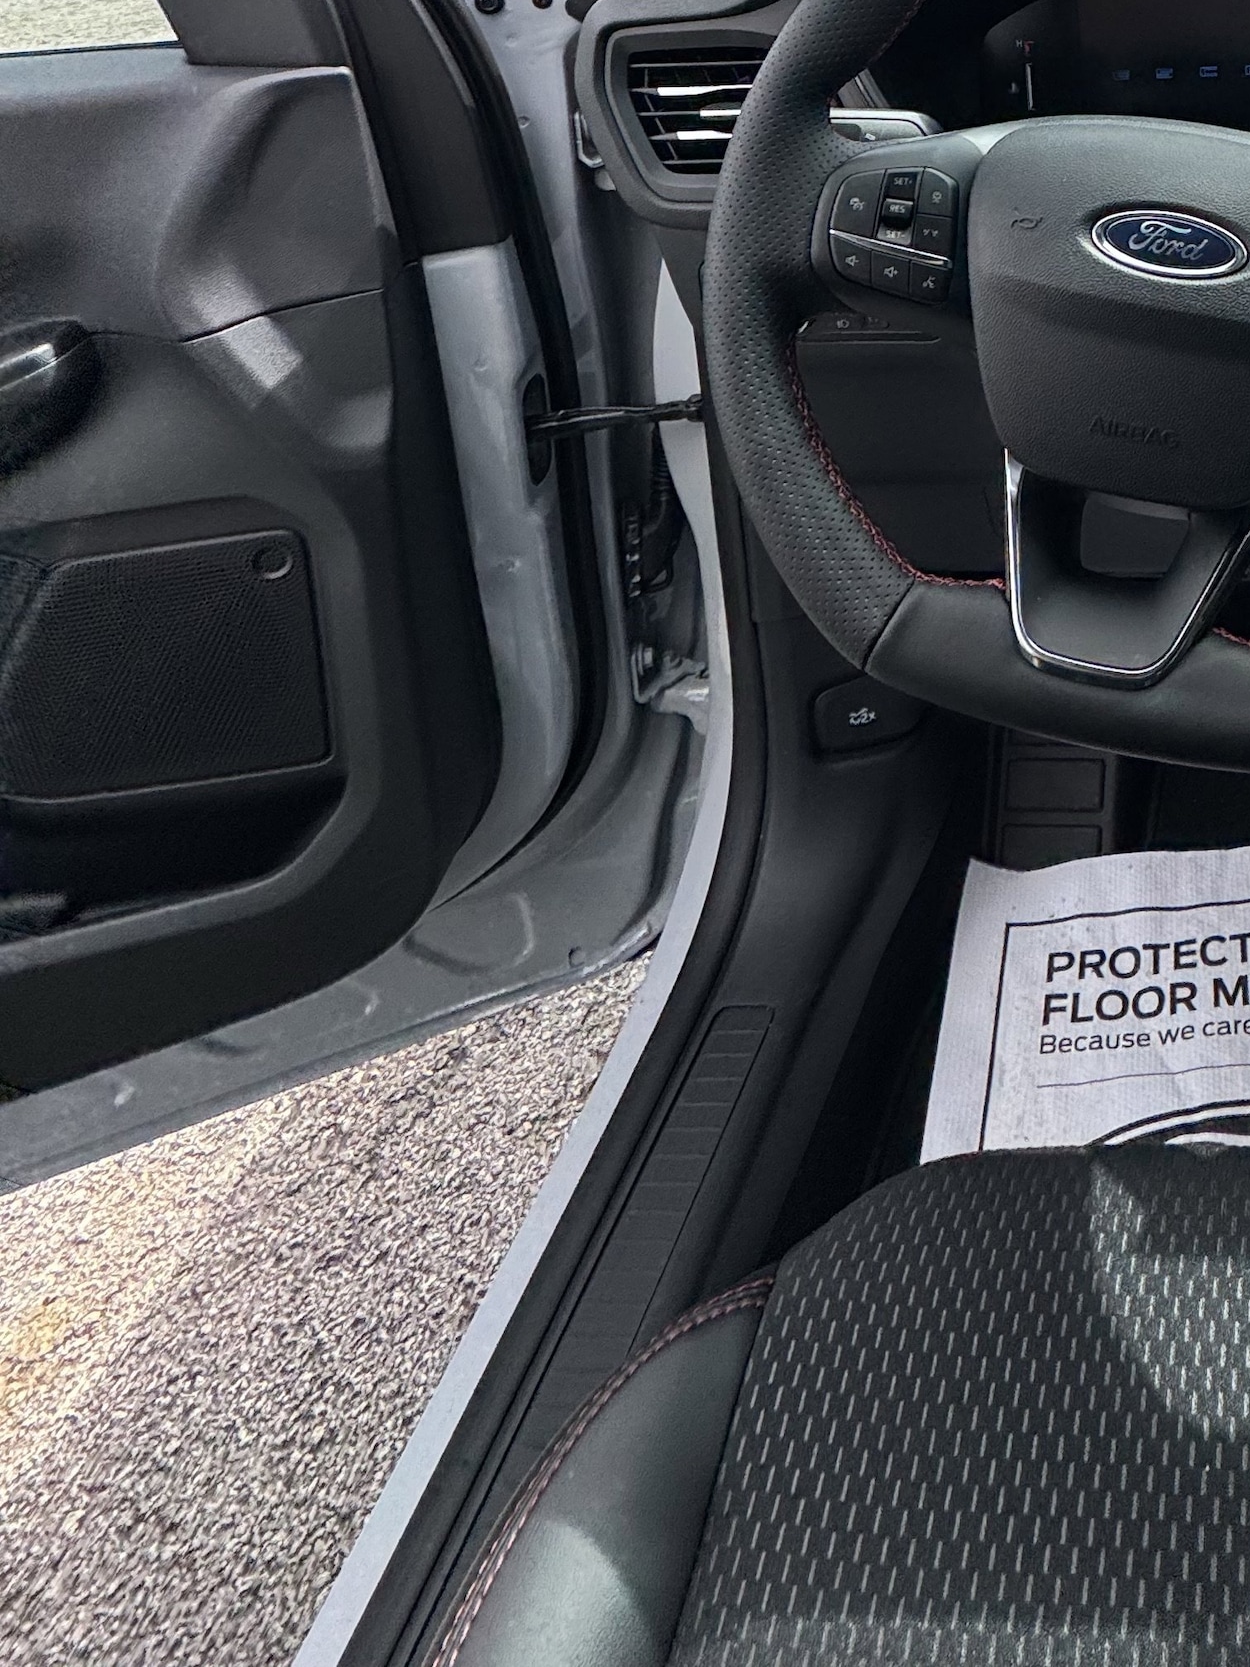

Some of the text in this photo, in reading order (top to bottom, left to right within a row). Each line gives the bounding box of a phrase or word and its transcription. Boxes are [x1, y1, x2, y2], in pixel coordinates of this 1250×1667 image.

[889, 204, 906, 214] RES
[1128, 220, 1208, 261] Ford
[1088, 415, 1181, 450] AIRBAG
[1042, 981, 1197, 1026] FLOOR
[1039, 1034, 1151, 1054] Because
[1158, 1024, 1195, 1044] we
